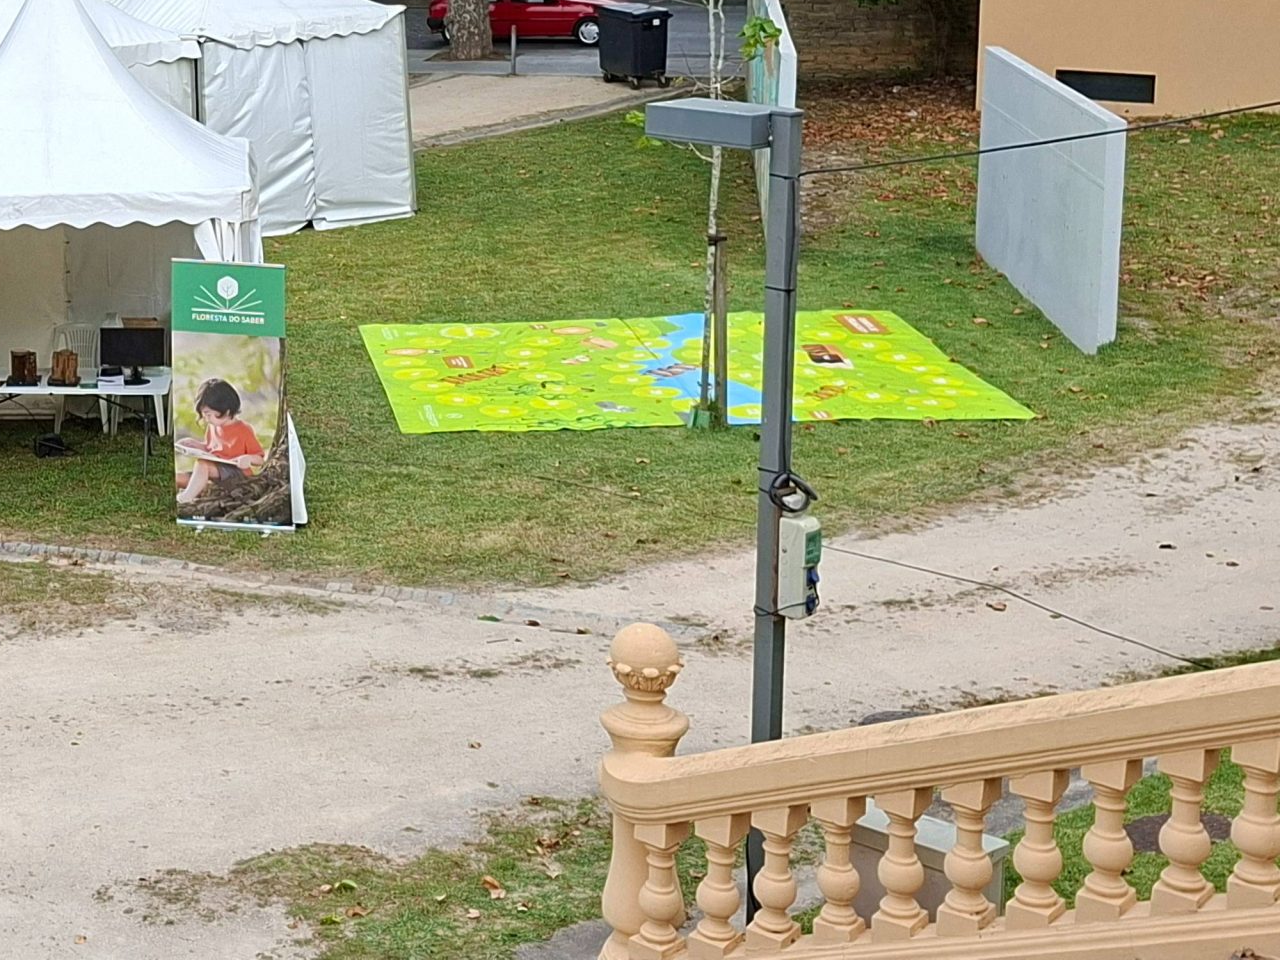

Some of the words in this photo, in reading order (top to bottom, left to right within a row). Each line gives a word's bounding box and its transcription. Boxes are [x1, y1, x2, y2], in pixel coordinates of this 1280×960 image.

[192, 313, 228, 322] FLORESTA
[228, 315, 240, 323] DO
[241, 316, 265, 325] SABER
